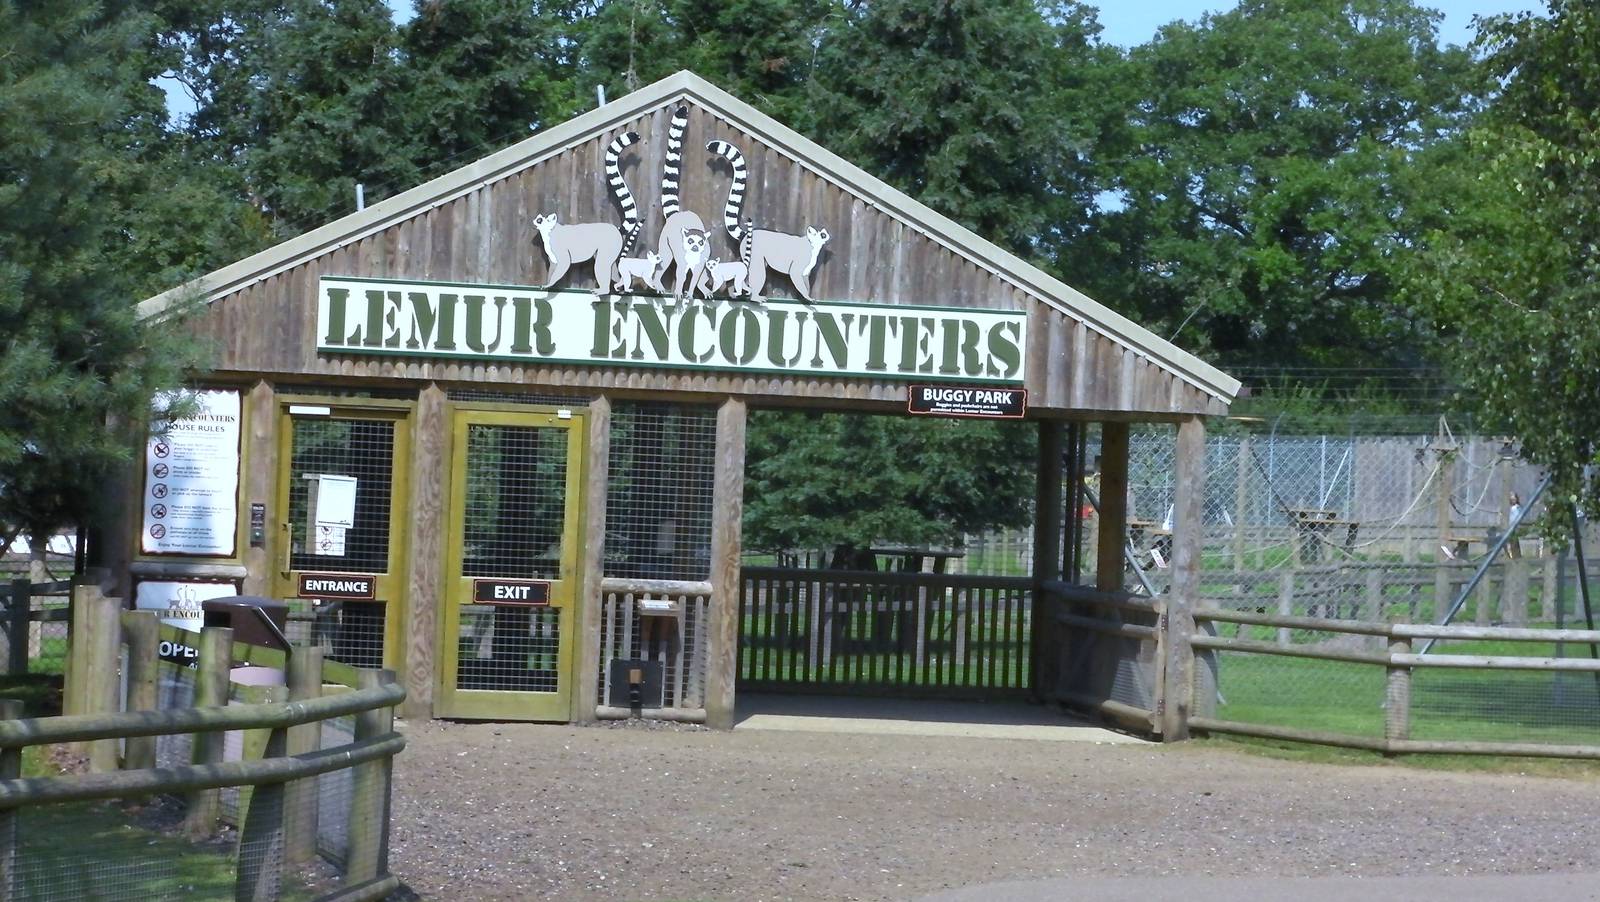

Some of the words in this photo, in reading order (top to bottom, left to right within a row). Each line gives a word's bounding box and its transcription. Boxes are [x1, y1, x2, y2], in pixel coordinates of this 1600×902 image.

[325, 287, 556, 356] LEMUR
[590, 300, 1021, 379] ENCOUNTERS
[923, 388, 973, 402] BUGGY
[975, 391, 1012, 404] PARK
[305, 579, 368, 593] ENTRANCE
[494, 585, 531, 600] EXIT
